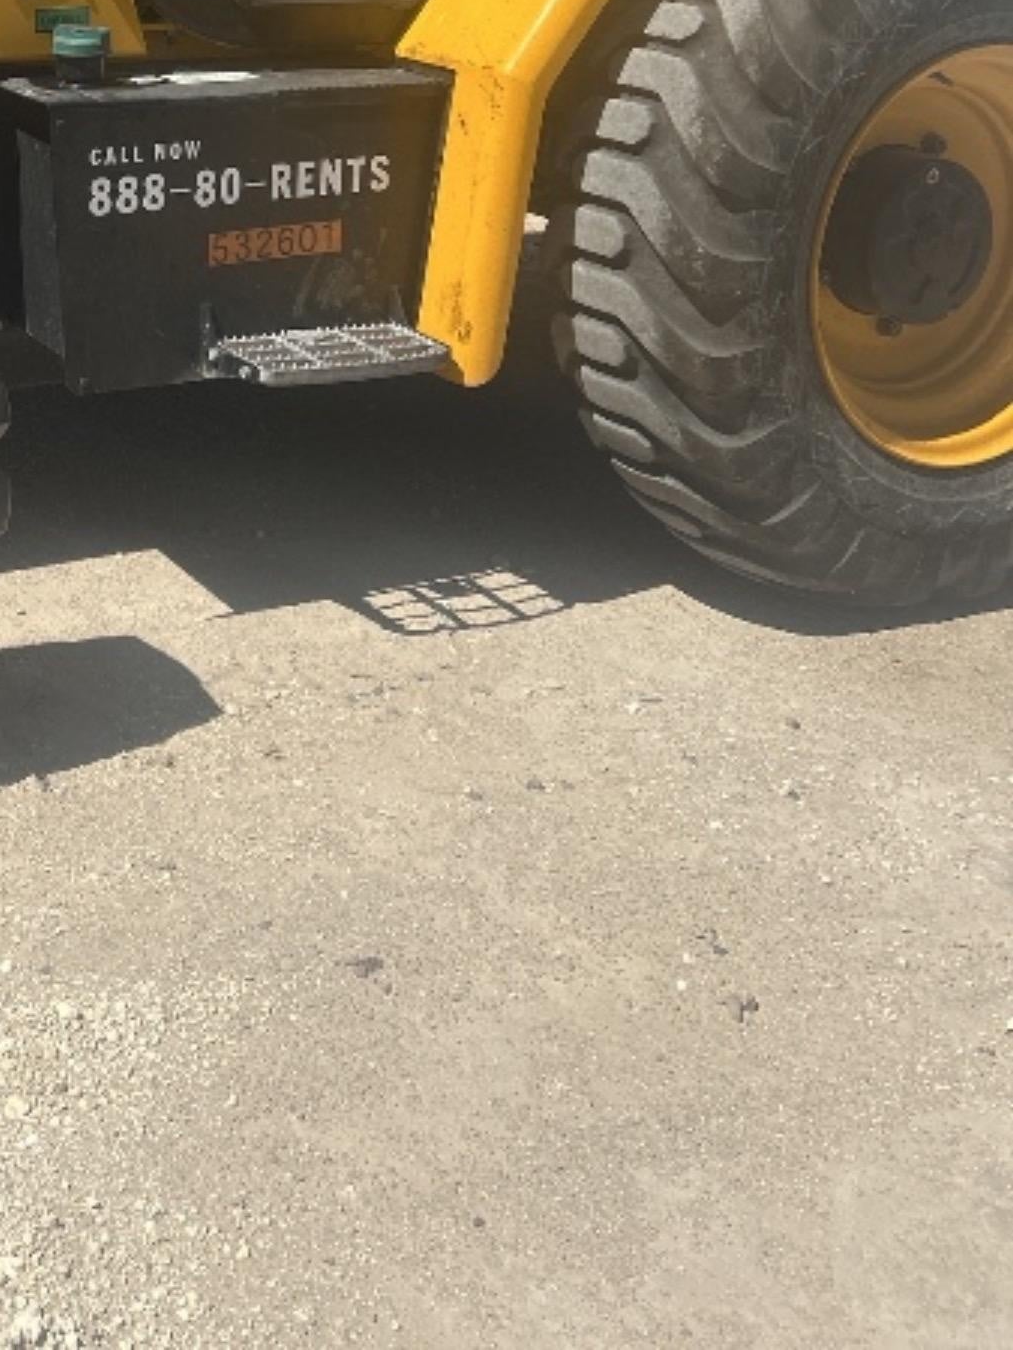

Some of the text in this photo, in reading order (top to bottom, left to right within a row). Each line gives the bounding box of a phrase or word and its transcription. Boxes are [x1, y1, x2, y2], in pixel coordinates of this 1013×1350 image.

[89, 139, 202, 167] CALL NOW
[88, 154, 391, 217] 888-80-RENTS
[211, 224, 334, 264] 532601
